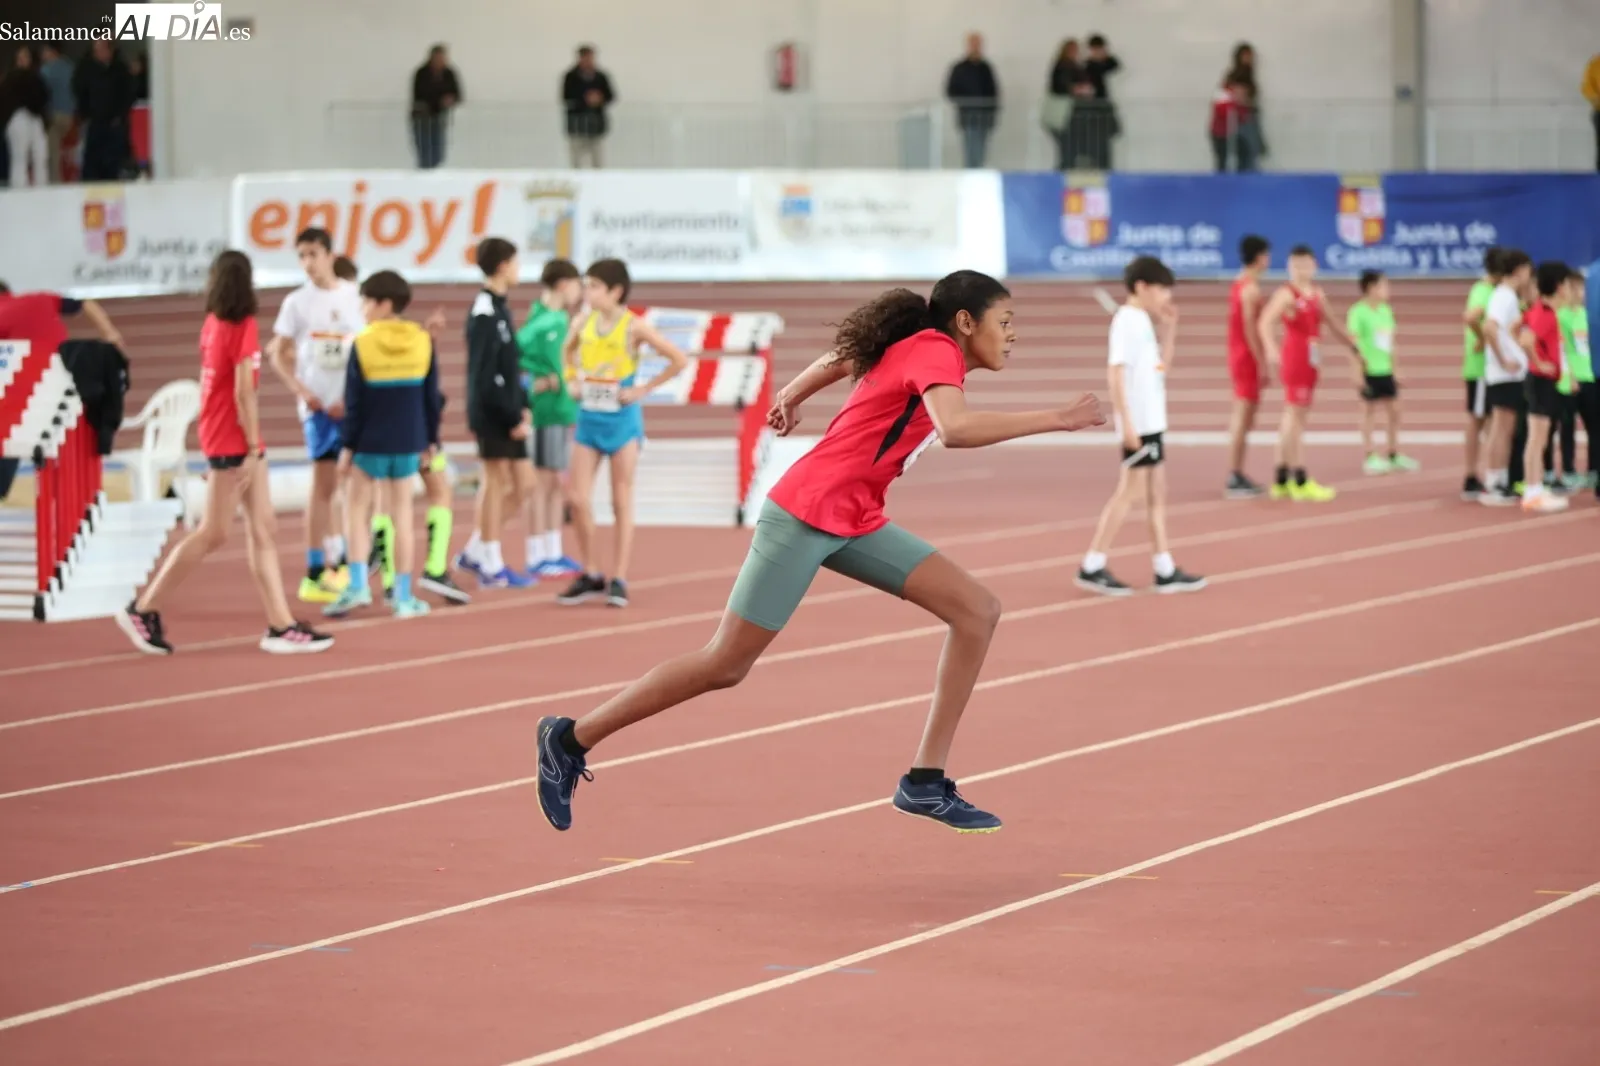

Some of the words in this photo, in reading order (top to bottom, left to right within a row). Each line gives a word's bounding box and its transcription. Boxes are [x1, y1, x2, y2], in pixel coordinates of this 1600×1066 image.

[248, 179, 497, 266] enjoy!
[1116, 222, 1185, 246] Junta
[1187, 222, 1222, 246] de
[1393, 221, 1460, 246] Junta
[1464, 221, 1497, 245] de
[1326, 244, 1413, 270] Castilla
[1417, 249, 1432, 274] y
